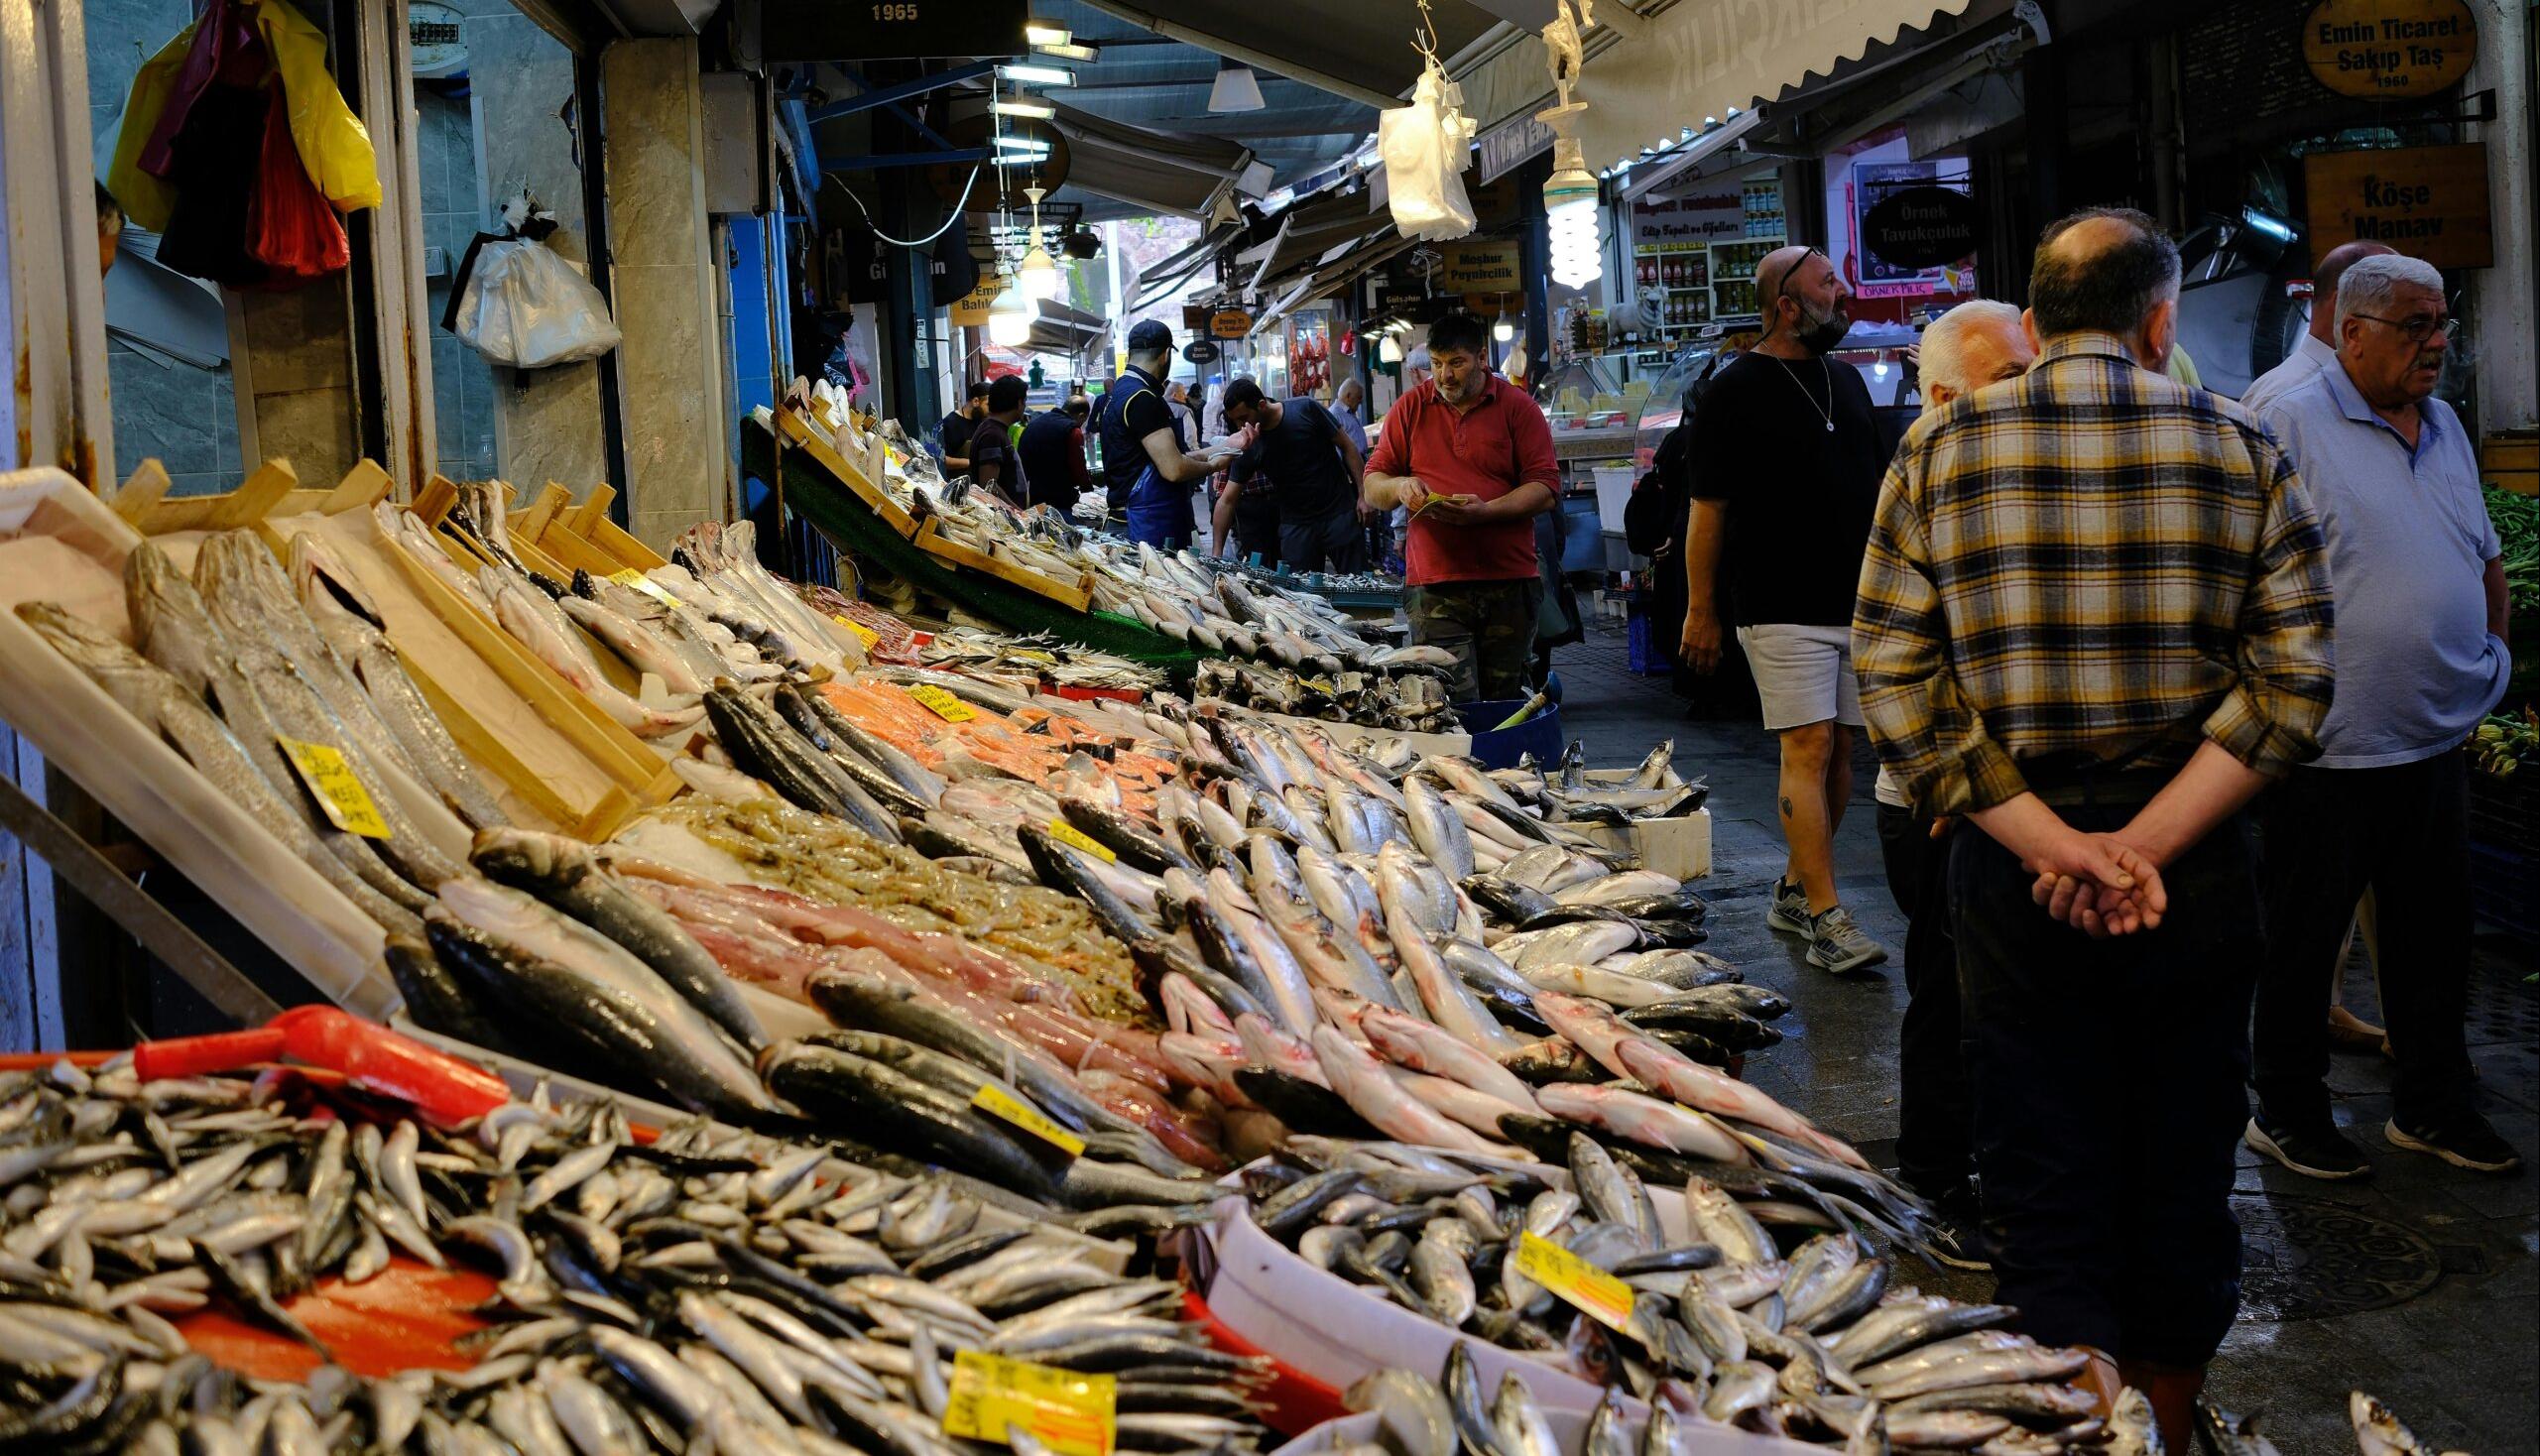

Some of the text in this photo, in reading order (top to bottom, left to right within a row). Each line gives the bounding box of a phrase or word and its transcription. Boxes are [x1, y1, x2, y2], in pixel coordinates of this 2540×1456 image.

[872, 4, 919, 22] 1965
[2319, 15, 2460, 45] Emin Ticaret
[2338, 46, 2444, 73] Sakıp Taş
[2377, 75, 2408, 87] 1960
[2364, 181, 2430, 214] Köşe
[1901, 201, 1948, 221] Örnek
[1641, 224, 1661, 239] Edip
[1880, 223, 1971, 245] Tavukçuluk
[2355, 215, 2444, 239] Manav
[976, 285, 999, 297] Emi
